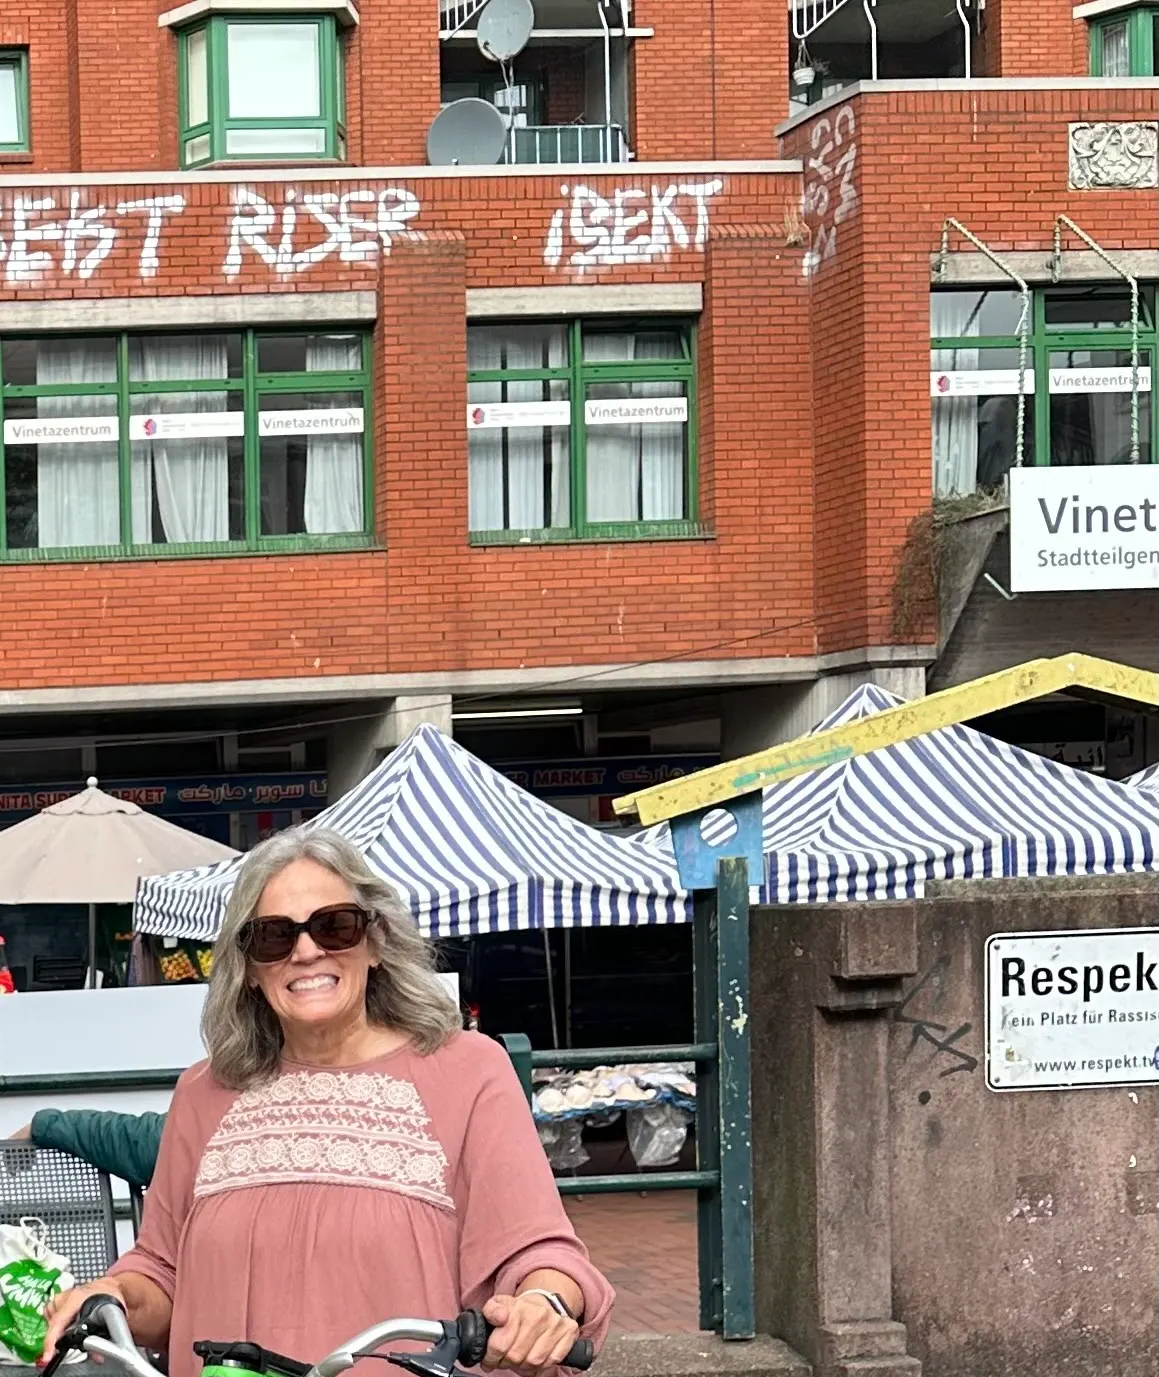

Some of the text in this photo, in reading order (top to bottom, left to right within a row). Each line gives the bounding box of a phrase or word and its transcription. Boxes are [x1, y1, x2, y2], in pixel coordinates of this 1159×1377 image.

[589, 404, 685, 418] Vinetazentrum
[12, 422, 112, 438] Vinetazentrum
[263, 414, 361, 430] Vinetazentrum
[1038, 495, 1157, 534] Vinet
[534, 768, 606, 787] MARKET
[1002, 952, 1158, 1002] Respek
[1040, 1012, 1078, 1026] Platz
[1083, 1010, 1103, 1024] für
[1108, 1008, 1159, 1024] Rassis
